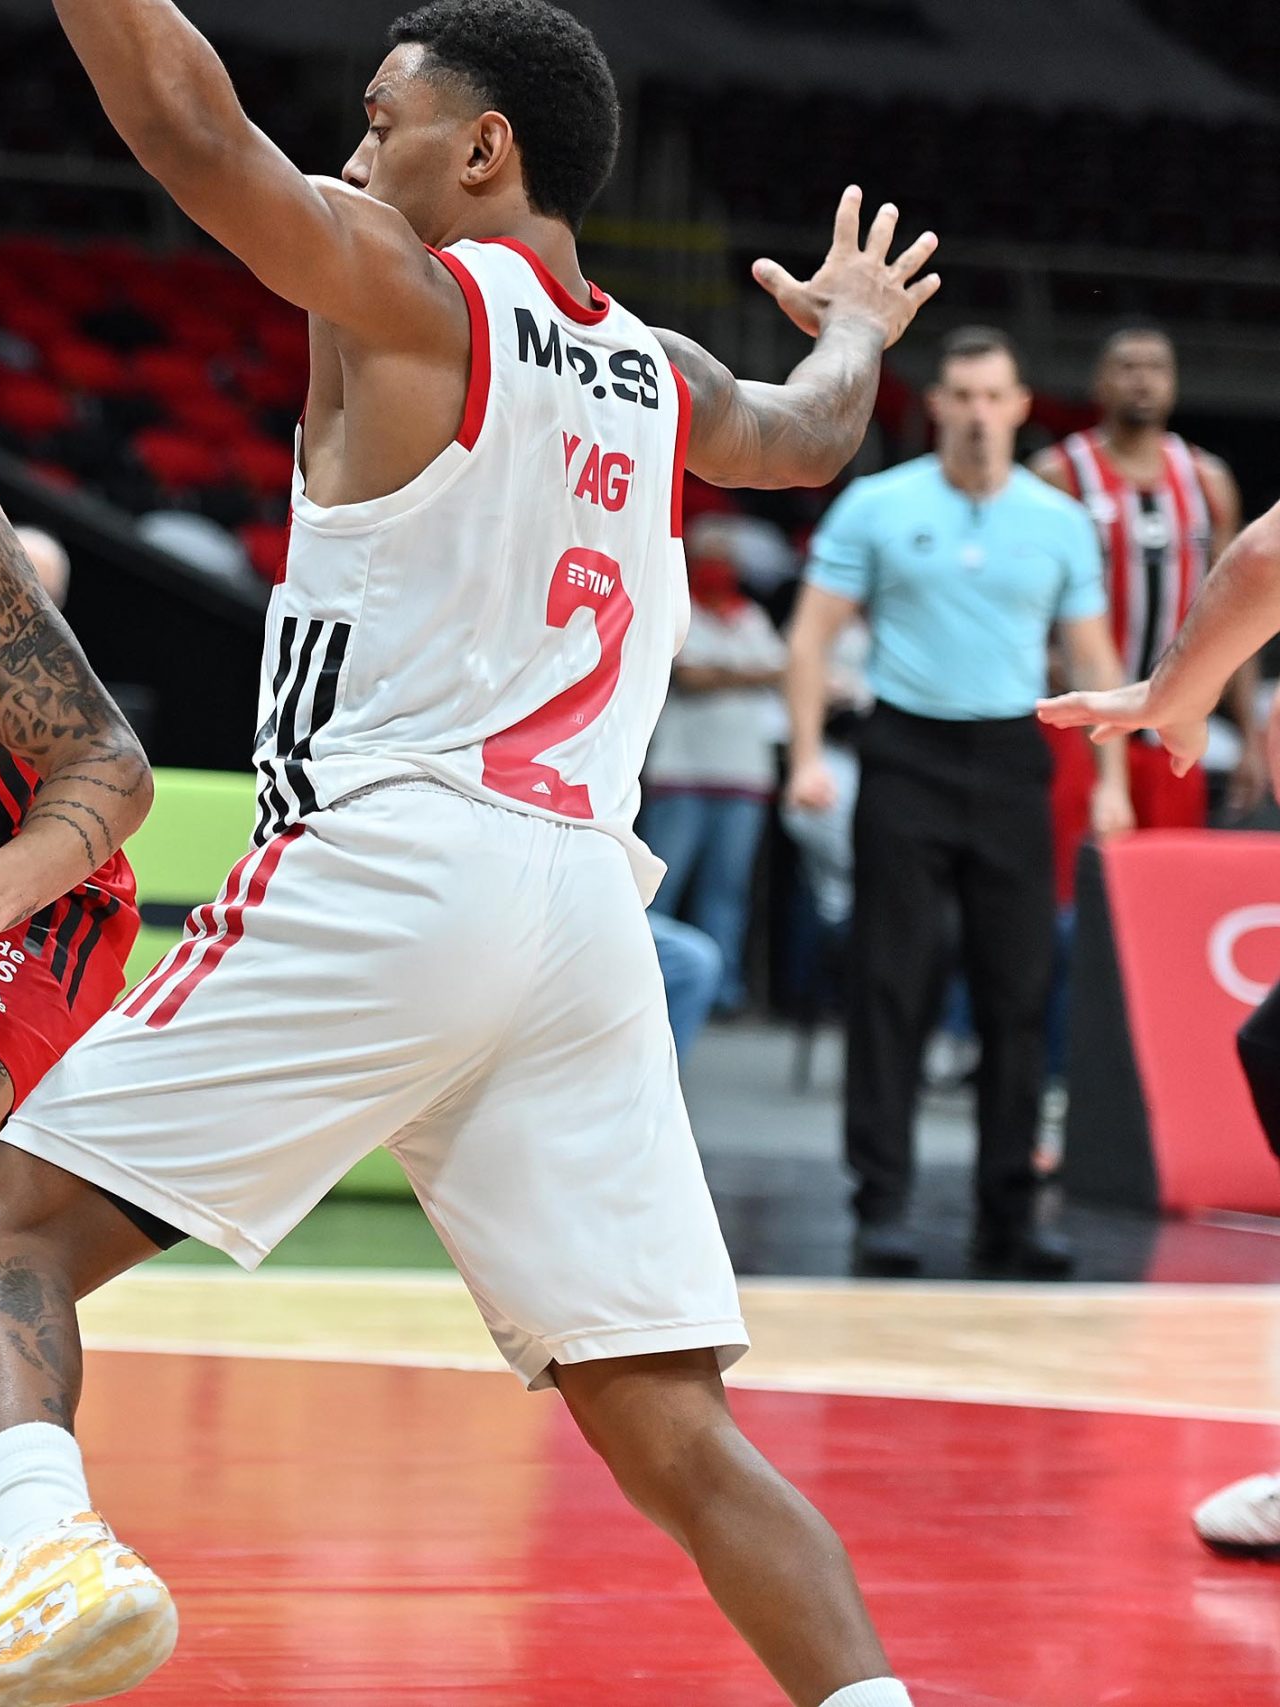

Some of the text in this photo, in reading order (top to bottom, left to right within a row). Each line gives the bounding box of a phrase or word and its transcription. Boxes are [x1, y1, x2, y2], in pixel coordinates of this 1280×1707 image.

[562, 430, 635, 512] YAG
[585, 569, 616, 598] TIM
[482, 546, 634, 820] 2
